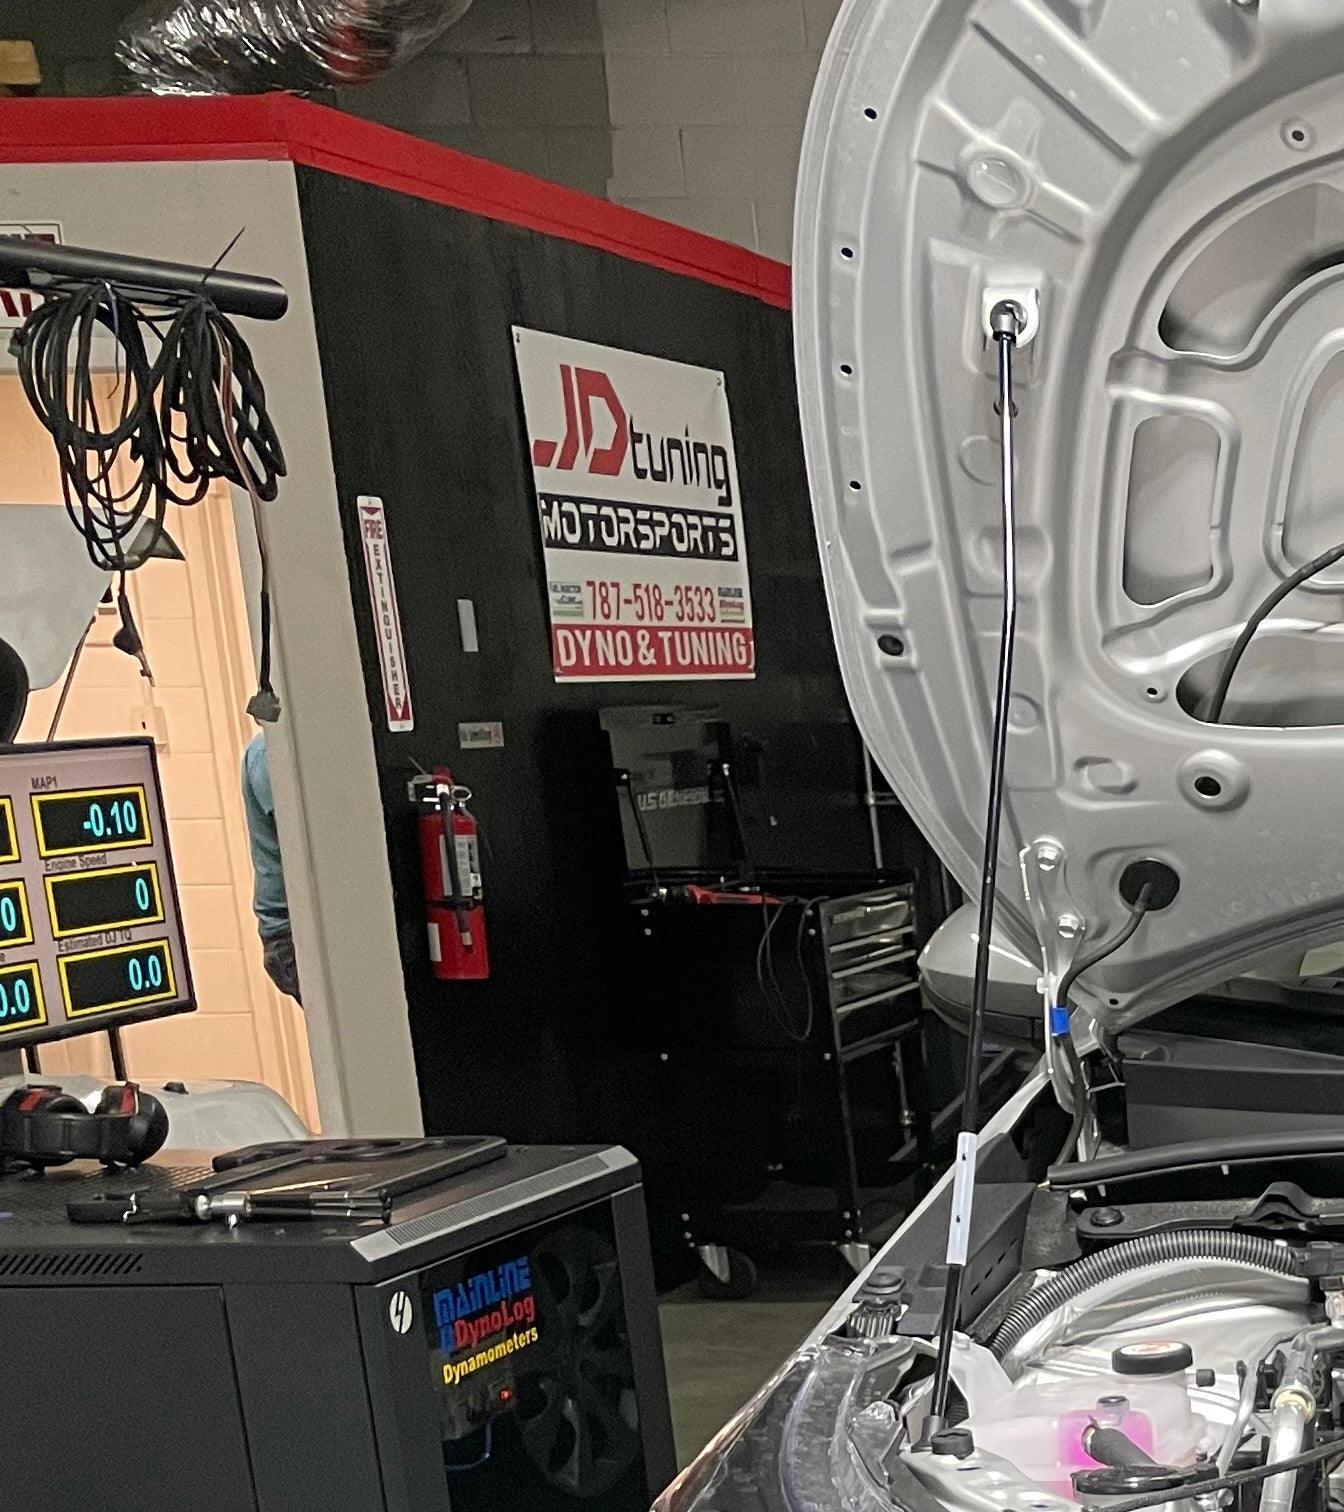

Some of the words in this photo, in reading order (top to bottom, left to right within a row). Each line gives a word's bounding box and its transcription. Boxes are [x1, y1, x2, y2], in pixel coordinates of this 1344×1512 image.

[364, 519, 384, 539] FIRE
[541, 499, 736, 557] MOTORSPORTS
[586, 581, 717, 624] 787-518-3533
[373, 544, 402, 709] EXTINGUISHER
[557, 629, 634, 667] DYNO
[637, 629, 657, 666] &
[659, 631, 747, 667] TUNING
[83, 800, 138, 838] -0.10
[135, 878, 149, 911] 0
[128, 955, 162, 991] 0.0
[442, 1326, 539, 1385] Dynamometers
